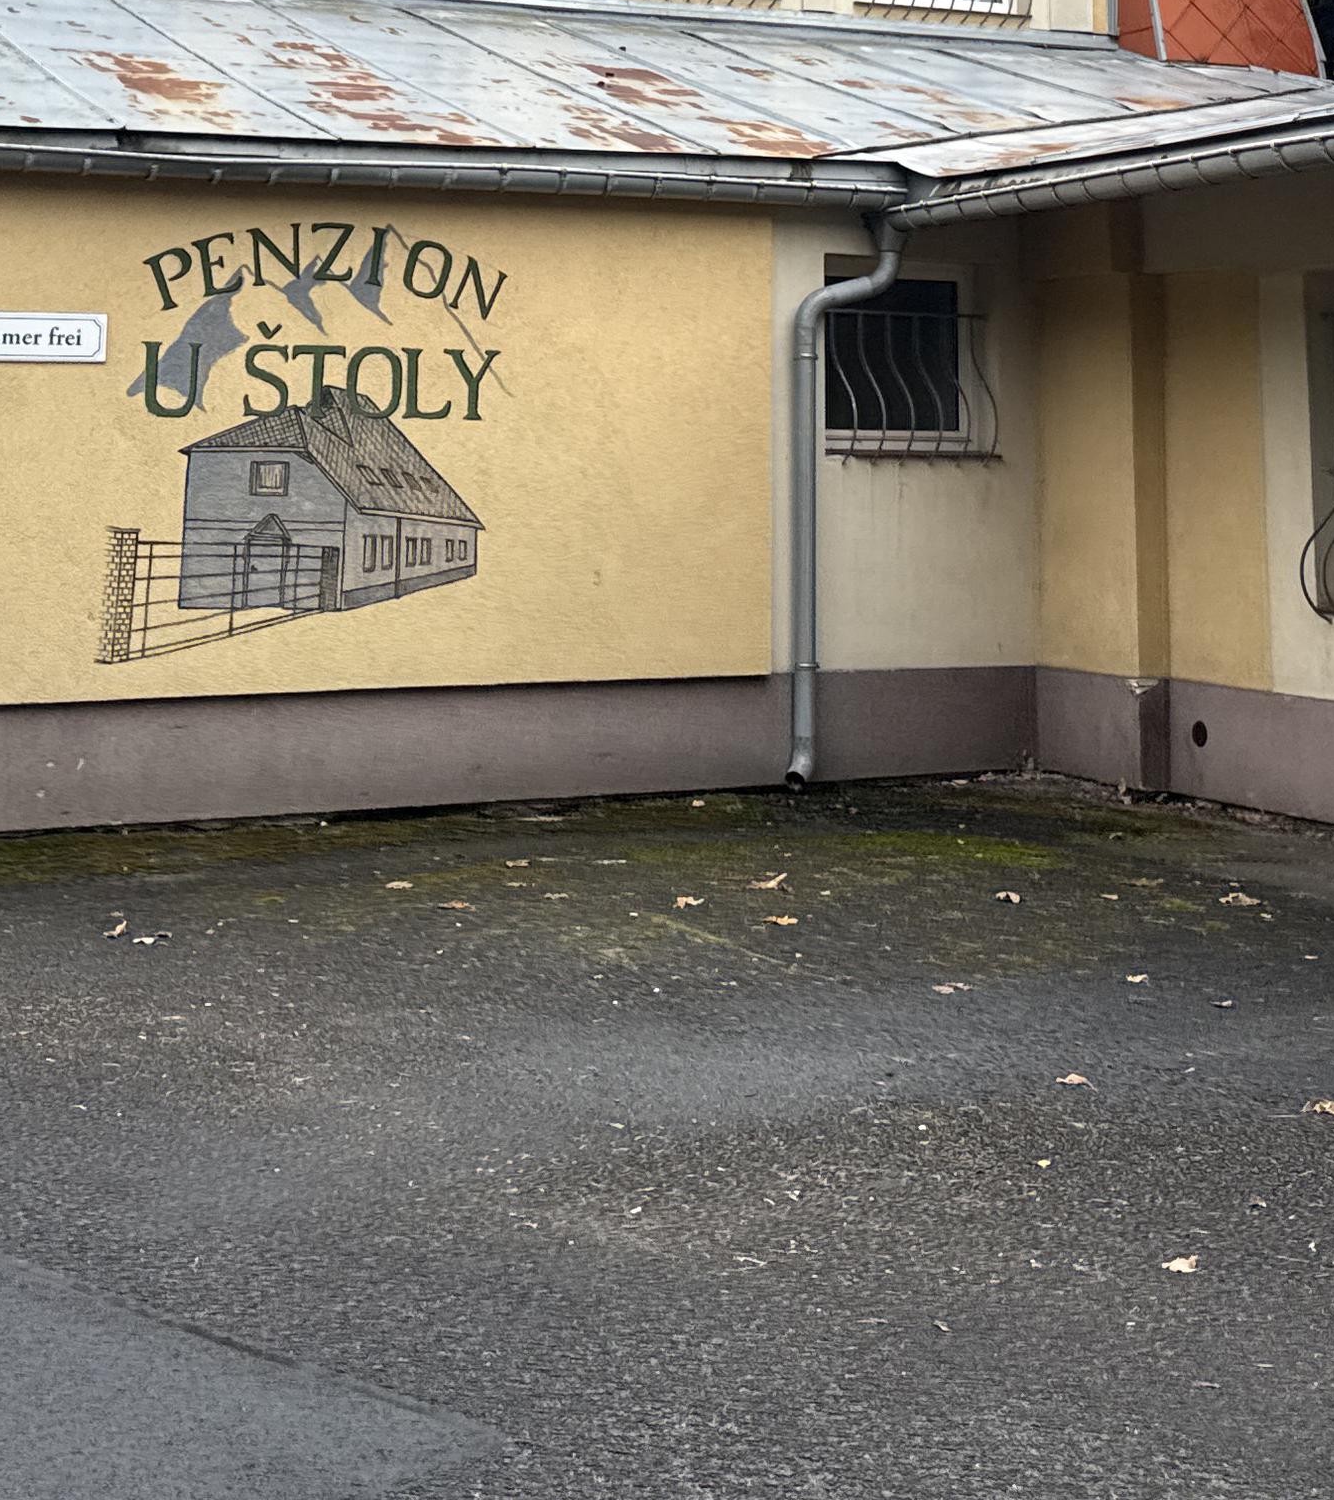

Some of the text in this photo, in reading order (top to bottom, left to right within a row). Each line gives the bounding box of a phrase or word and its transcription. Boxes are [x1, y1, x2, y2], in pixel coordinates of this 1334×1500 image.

[142, 222, 508, 320] PENZION
[48, 326, 82, 346] frei
[142, 321, 501, 420] U ŠTOLY
